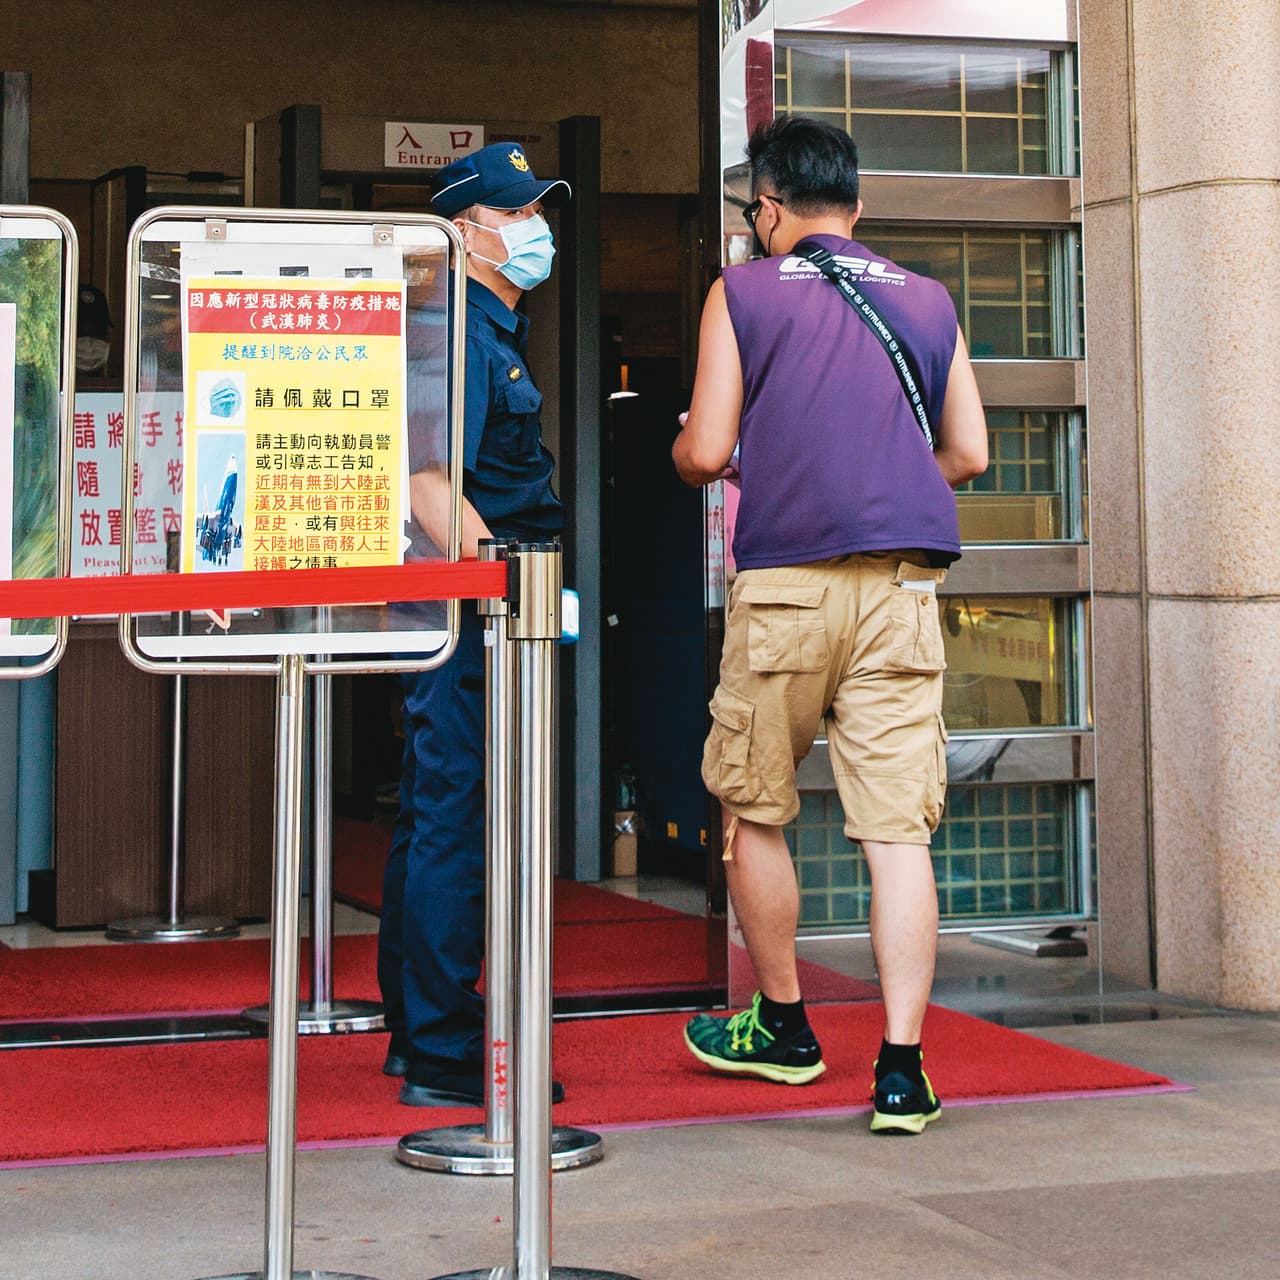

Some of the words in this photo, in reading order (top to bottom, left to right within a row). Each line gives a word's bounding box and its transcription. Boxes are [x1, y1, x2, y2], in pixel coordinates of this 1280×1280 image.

[395, 126, 473, 150] 入口
[398, 151, 460, 166] Entran
[779, 273, 817, 281] GLOBAL
[859, 276, 906, 287] LOGISTICS
[190, 292, 401, 312] 因應新型冠狀病毒防疫措施
[222, 343, 369, 362] 提醒到院洽公民眾
[255, 387, 390, 409] 請佩戴口罩
[256, 433, 391, 450] 請主動向執勤員警
[255, 474, 391, 491] 近期有無到大陸武
[254, 494, 390, 511] 漢及其他省市活動
[254, 535, 389, 552] 大陸地區商務人士
